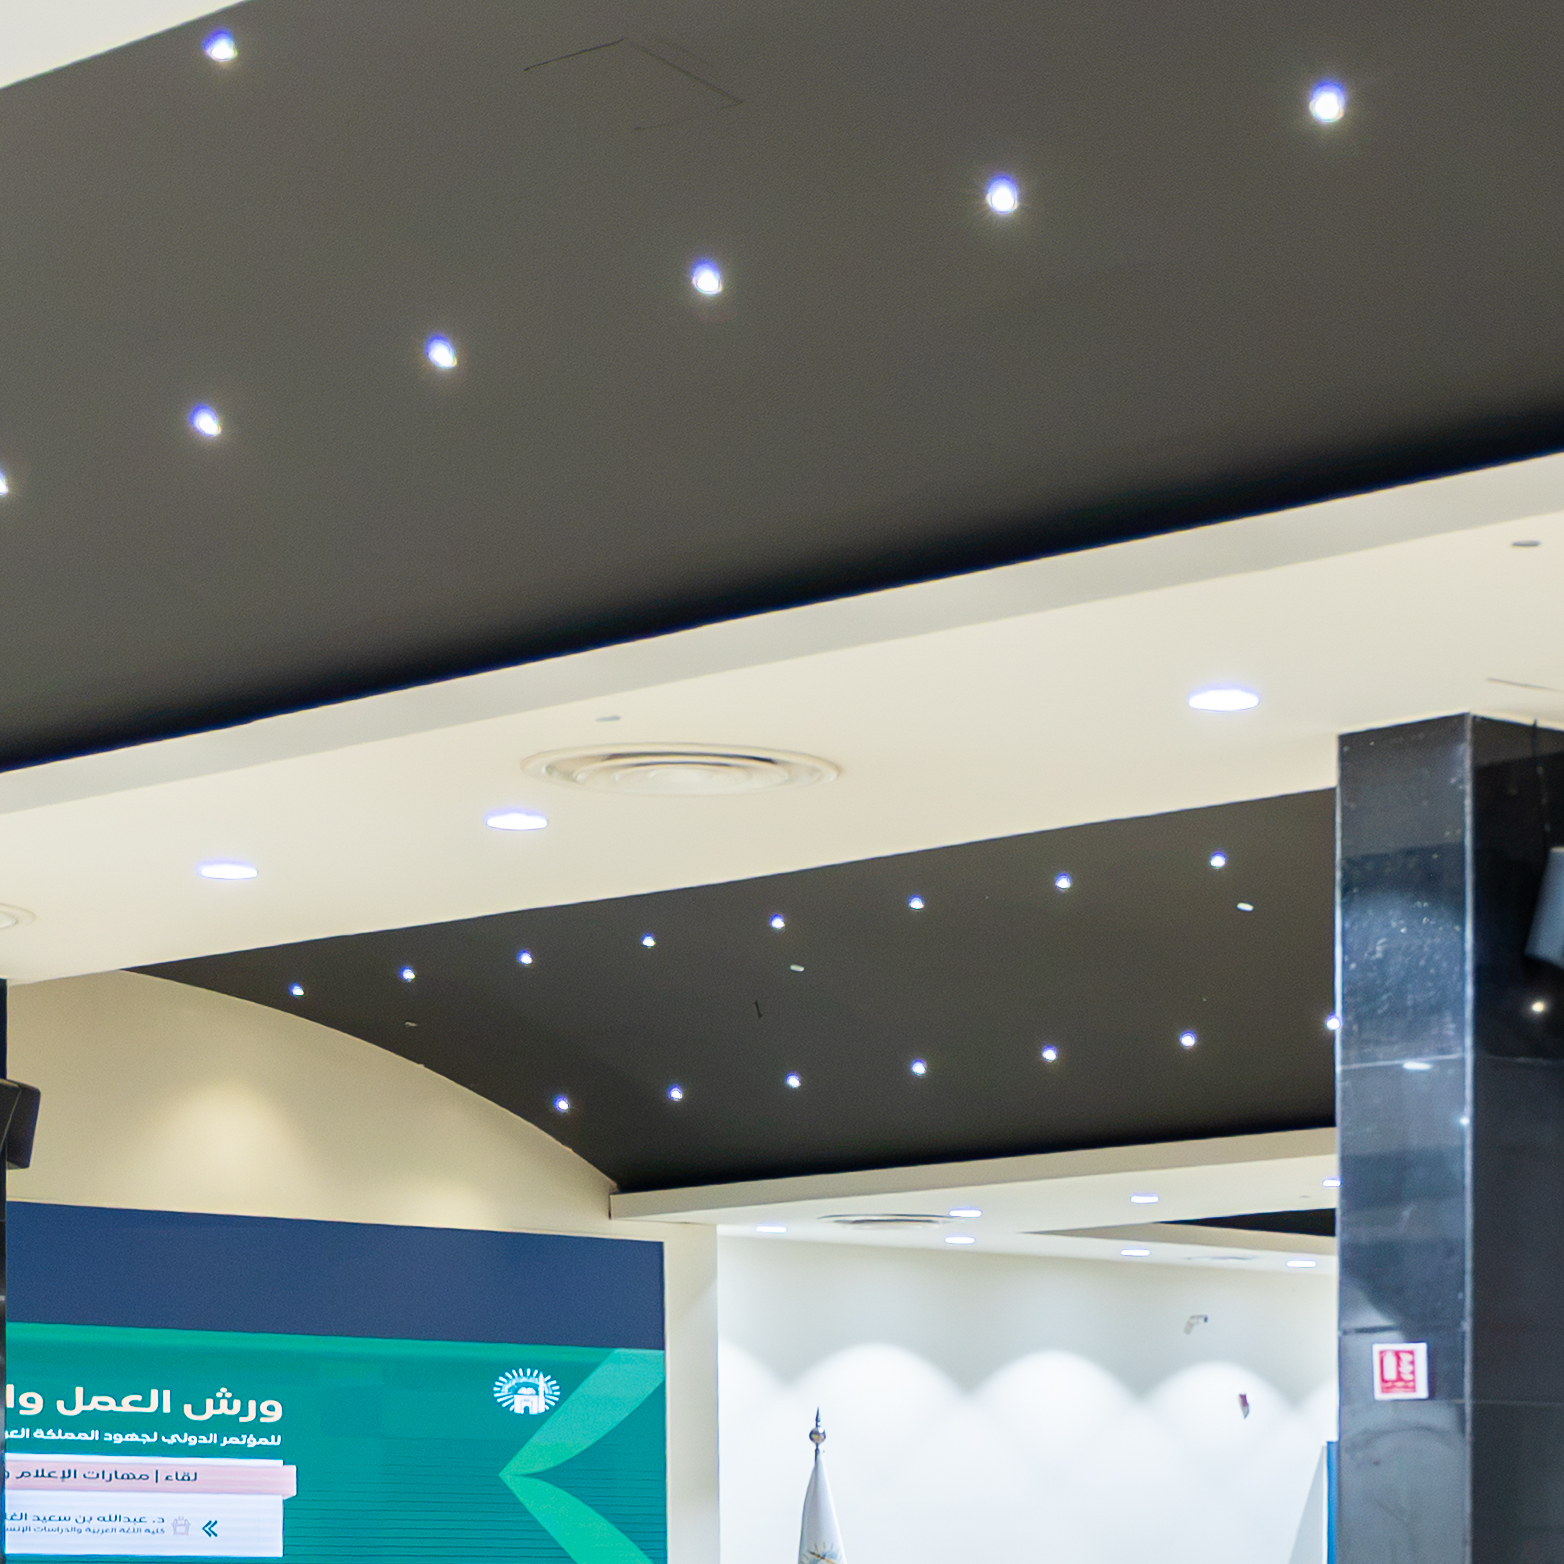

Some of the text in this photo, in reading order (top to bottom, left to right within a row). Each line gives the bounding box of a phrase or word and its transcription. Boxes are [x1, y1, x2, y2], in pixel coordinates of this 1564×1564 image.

[57, 1387, 170, 1415] العمل
[184, 1388, 282, 1422] ورش
[33, 1429, 99, 1440] المملكة
[104, 1432, 157, 1444] لجهود
[162, 1433, 217, 1445] الدولي
[220, 1434, 281, 1447] للمؤتمر
[16, 1468, 77, 1482] الإعلام
[83, 1470, 149, 1482] مهارات
[165, 1471, 197, 1481] لقاء
[32, 1515, 71, 1523] سعيد
[75, 1516, 92, 1524] بن
